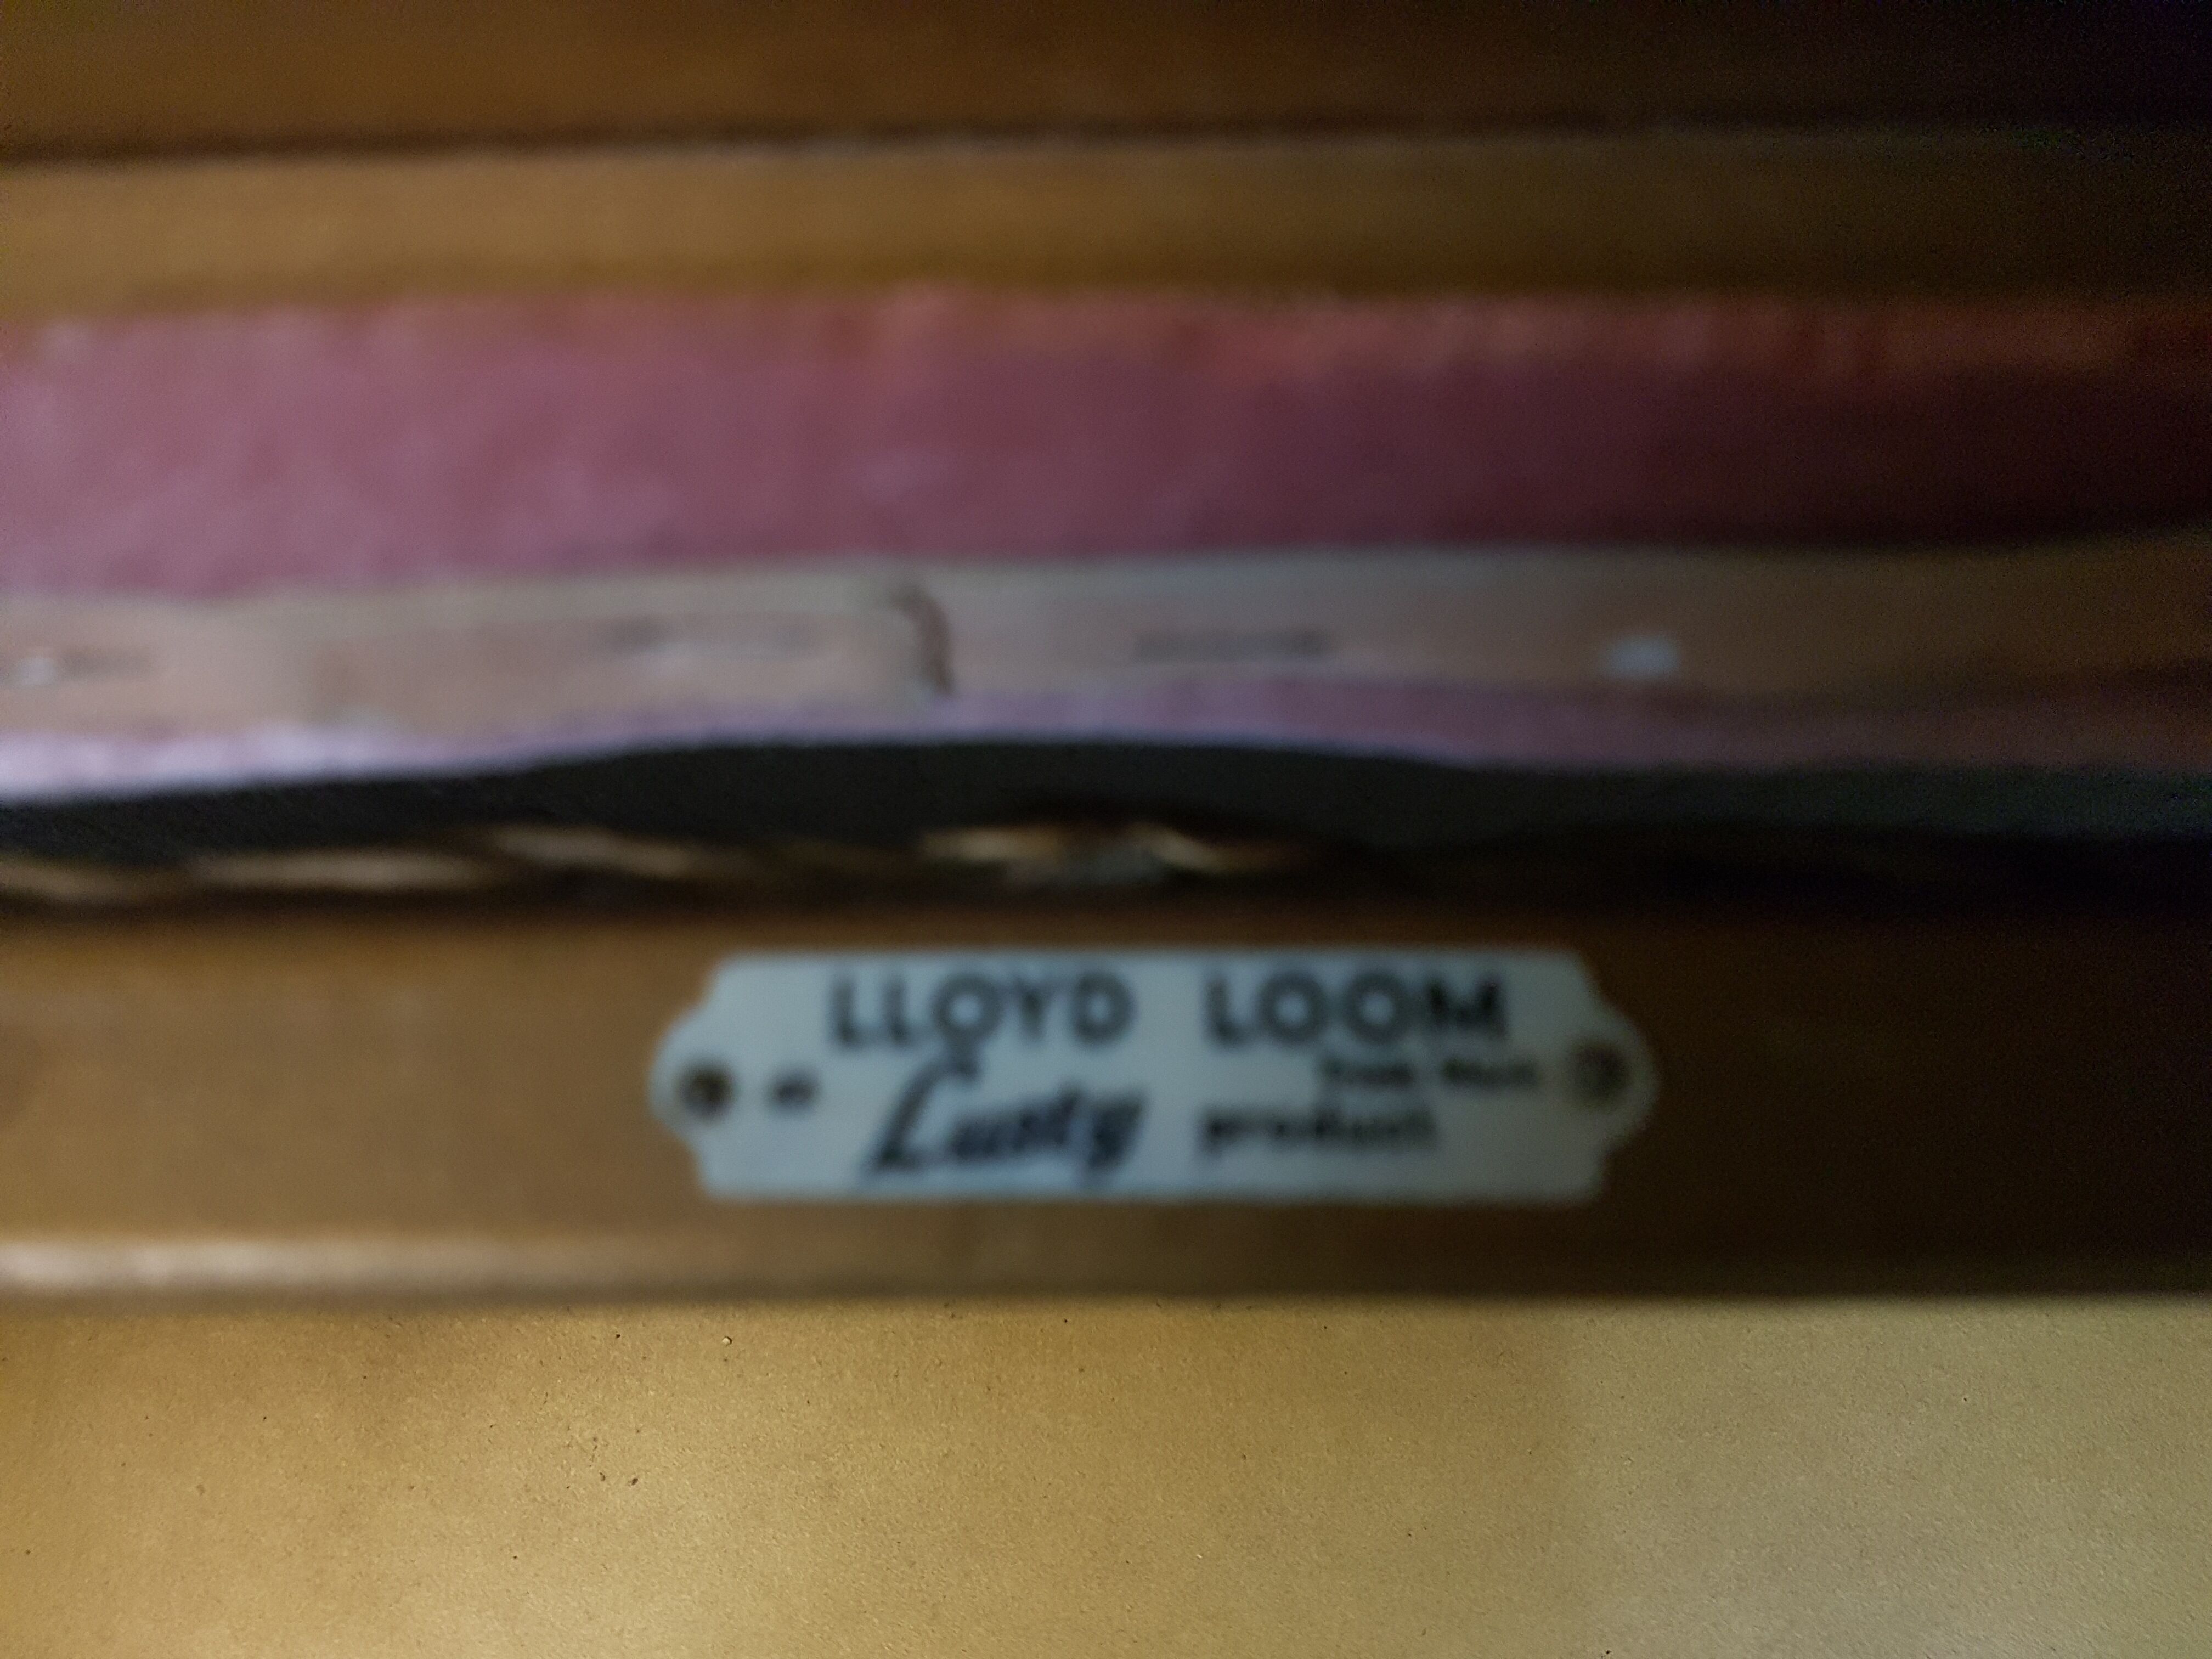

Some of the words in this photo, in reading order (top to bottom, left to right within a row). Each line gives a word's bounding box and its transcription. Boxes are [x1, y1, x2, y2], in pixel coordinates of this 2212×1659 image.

[831, 973, 1136, 1049] LLOYD
[1201, 973, 1509, 1048] LOOM
[864, 1048, 1150, 1188] Lusty
[1197, 1100, 1438, 1156] product
